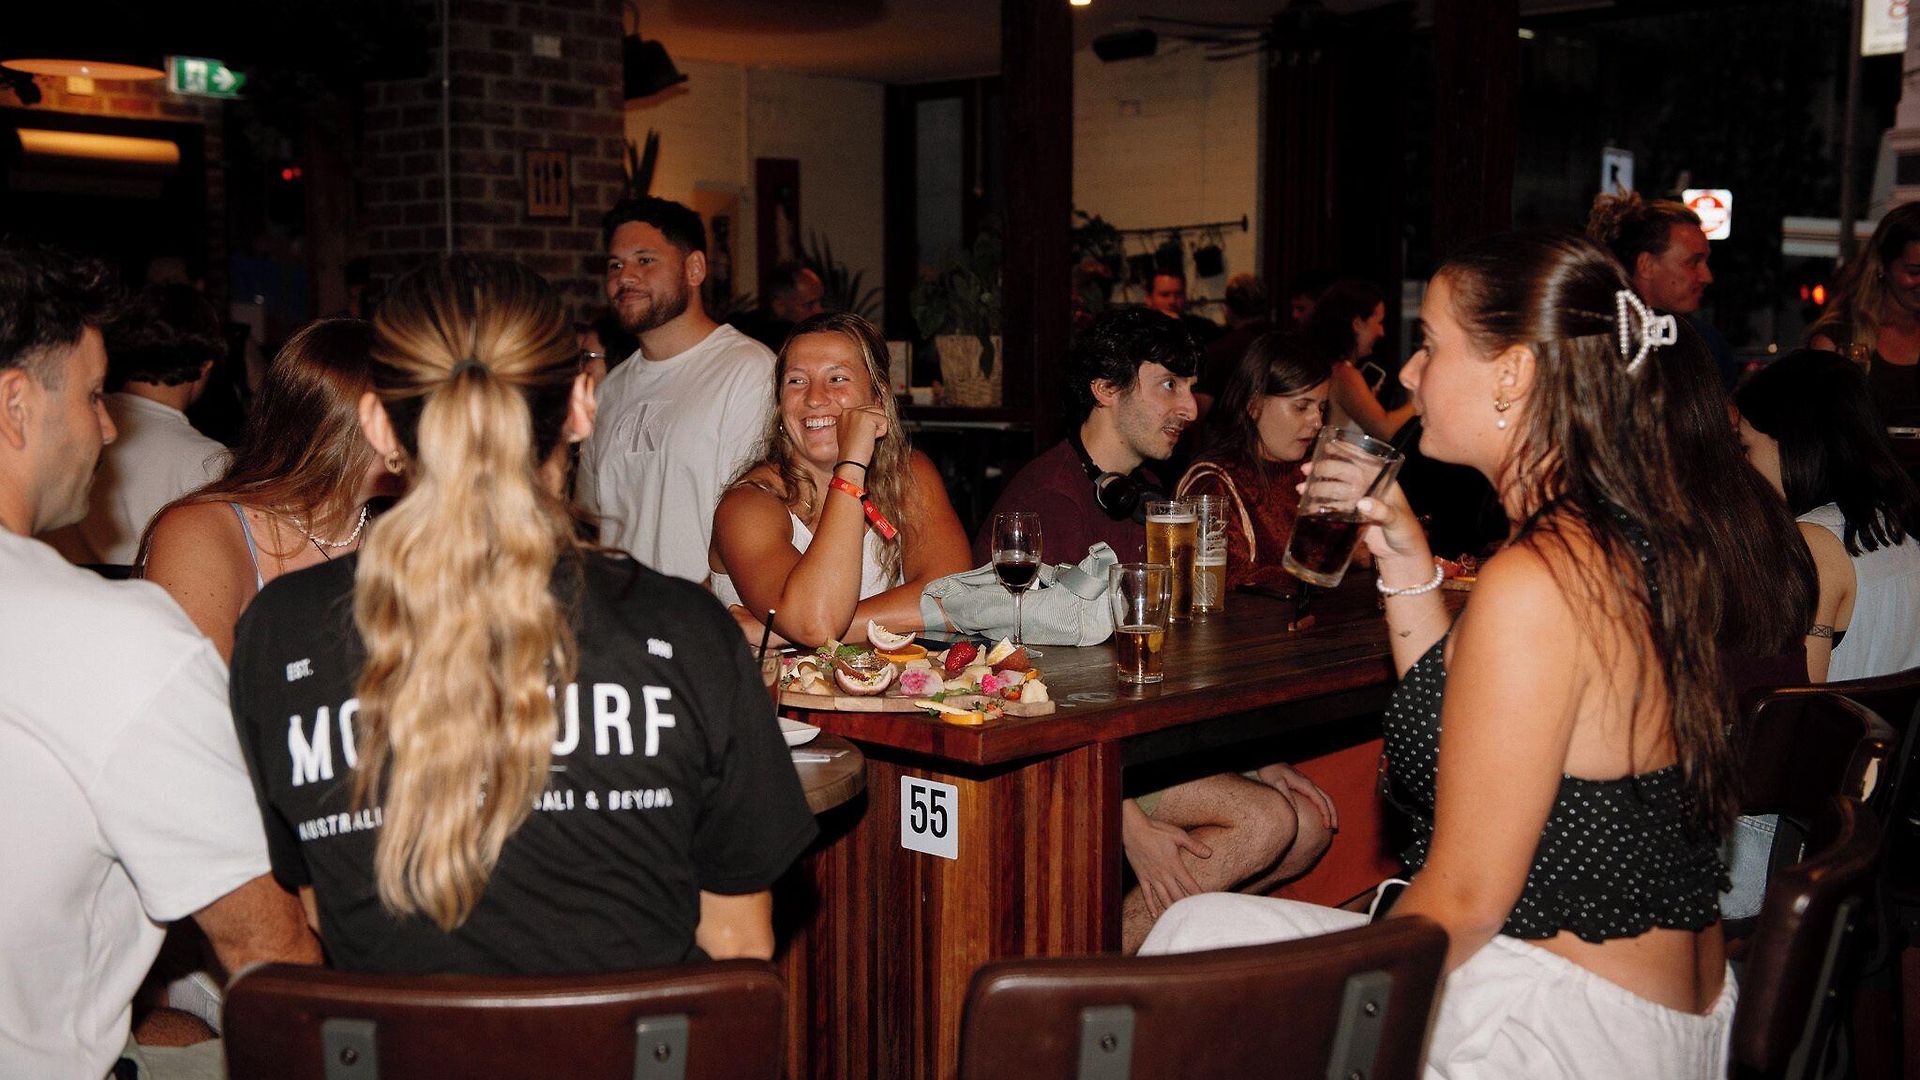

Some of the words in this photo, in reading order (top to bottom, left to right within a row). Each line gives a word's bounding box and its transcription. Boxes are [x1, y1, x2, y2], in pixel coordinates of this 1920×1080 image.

[546, 682, 677, 757] URF
[298, 806, 383, 841] AUSTRALI
[585, 790, 600, 811] &
[910, 783, 948, 838] 55
